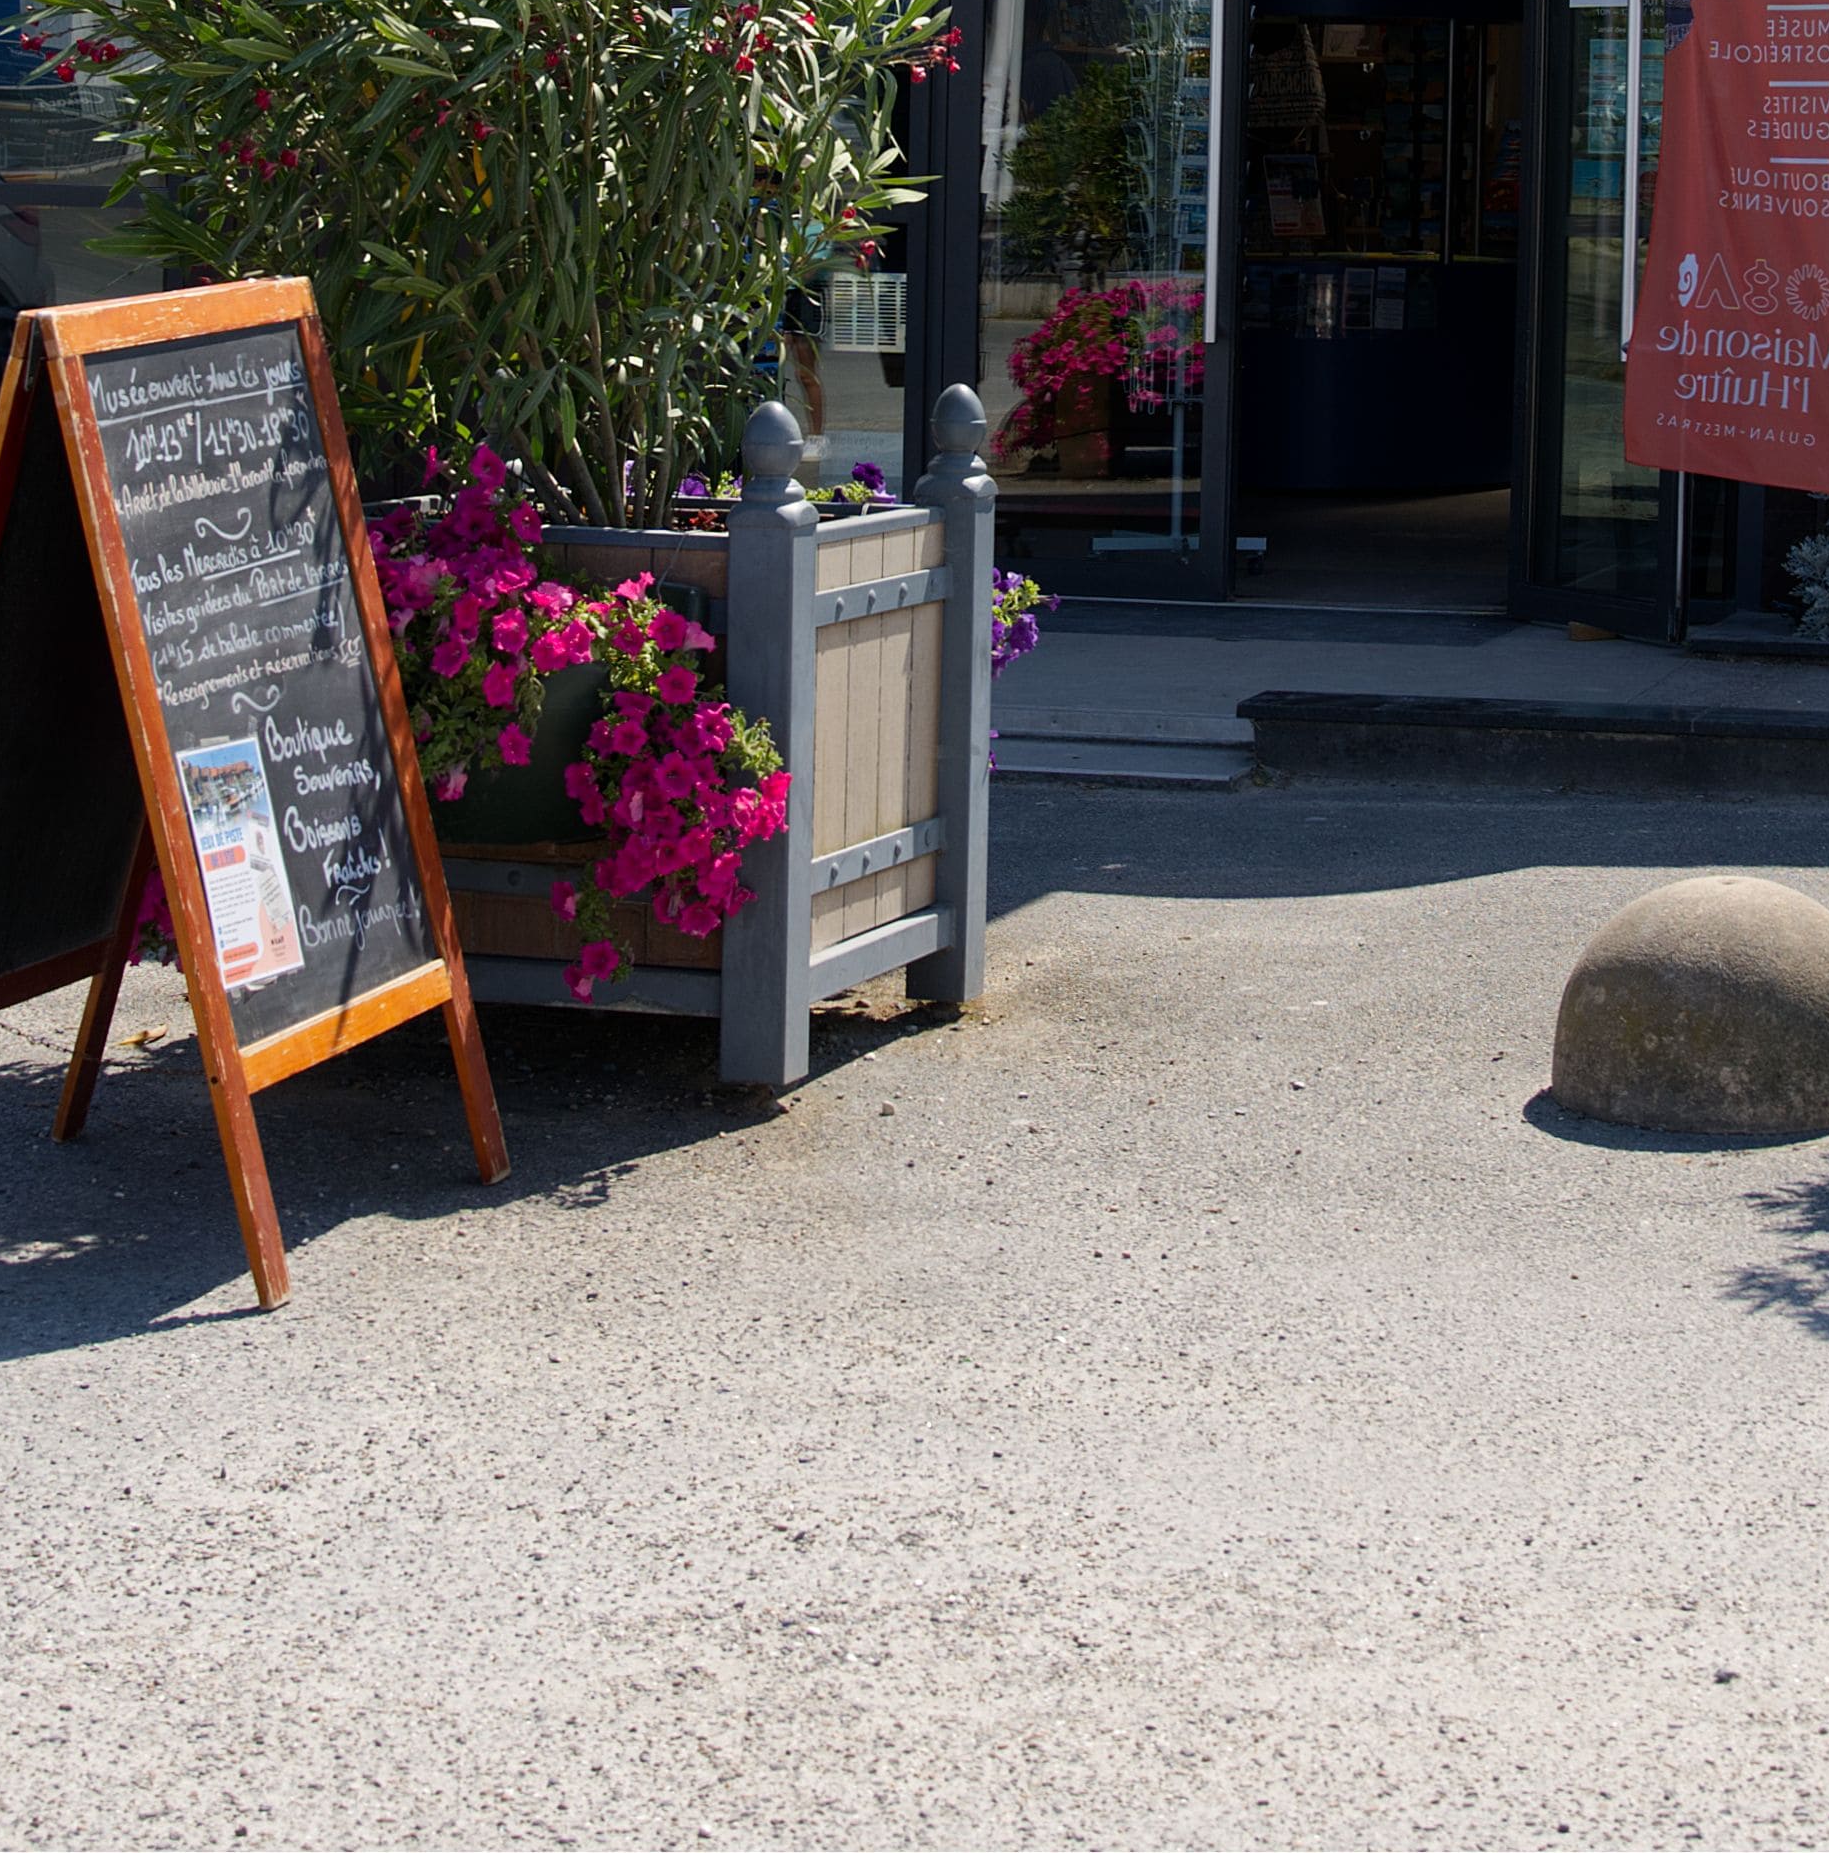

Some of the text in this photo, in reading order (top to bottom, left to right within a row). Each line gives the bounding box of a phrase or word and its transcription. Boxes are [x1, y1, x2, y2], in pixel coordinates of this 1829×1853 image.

[157, 548, 185, 586] les
[249, 534, 263, 560] à
[232, 583, 253, 607] du
[218, 620, 264, 658] balade
[263, 714, 355, 764] Boutique
[283, 804, 363, 854] Boissons
